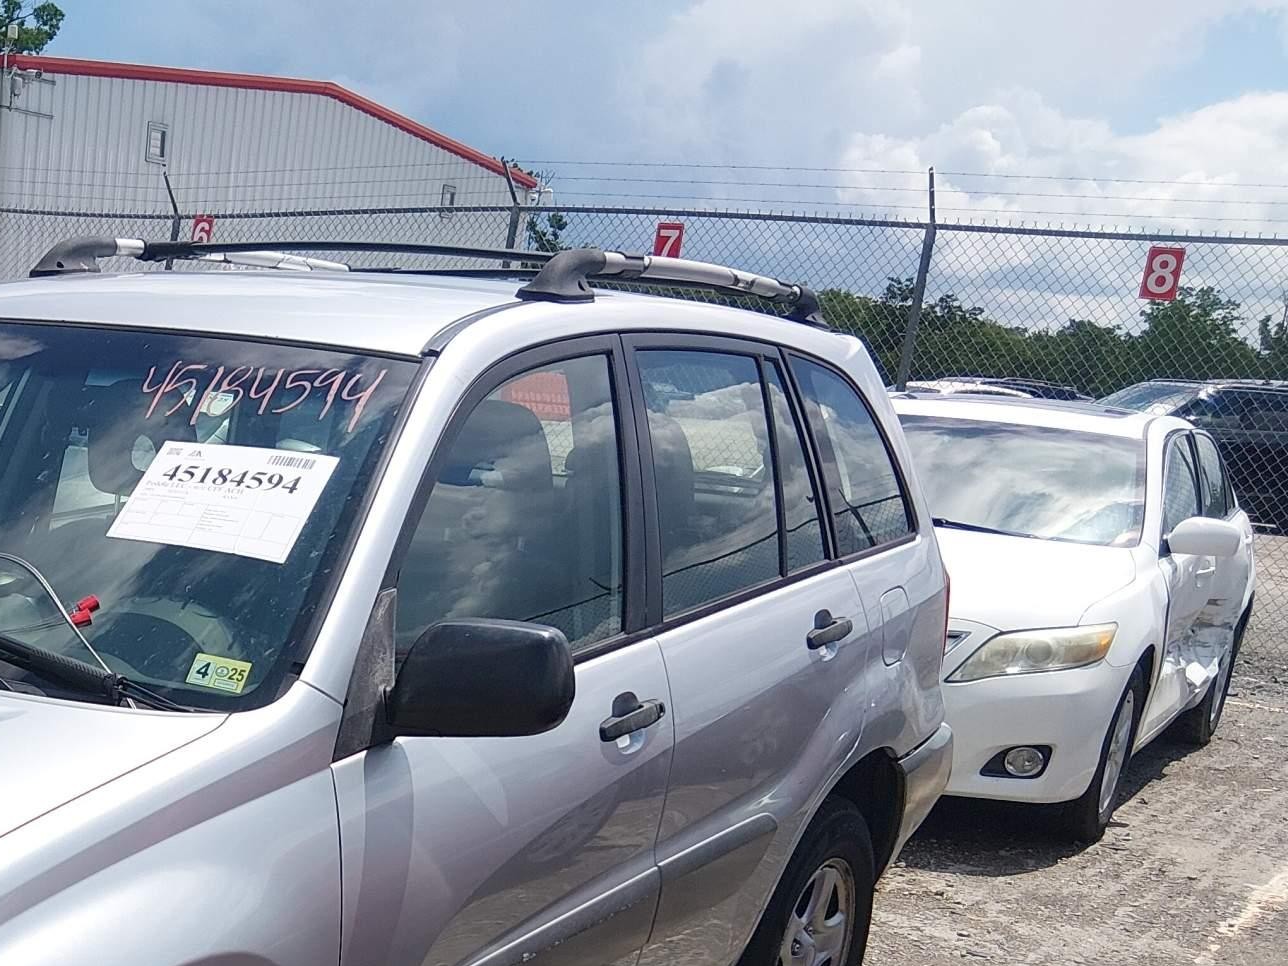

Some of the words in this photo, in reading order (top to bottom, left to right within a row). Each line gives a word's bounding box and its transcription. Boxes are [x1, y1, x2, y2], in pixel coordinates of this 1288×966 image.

[193, 221, 209, 242] 6
[660, 229, 681, 257] 7
[1146, 253, 1177, 294] 8
[141, 360, 388, 433] 45184594
[162, 462, 303, 495] 45184594
[195, 661, 212, 680] 4
[228, 667, 247, 682] 25
